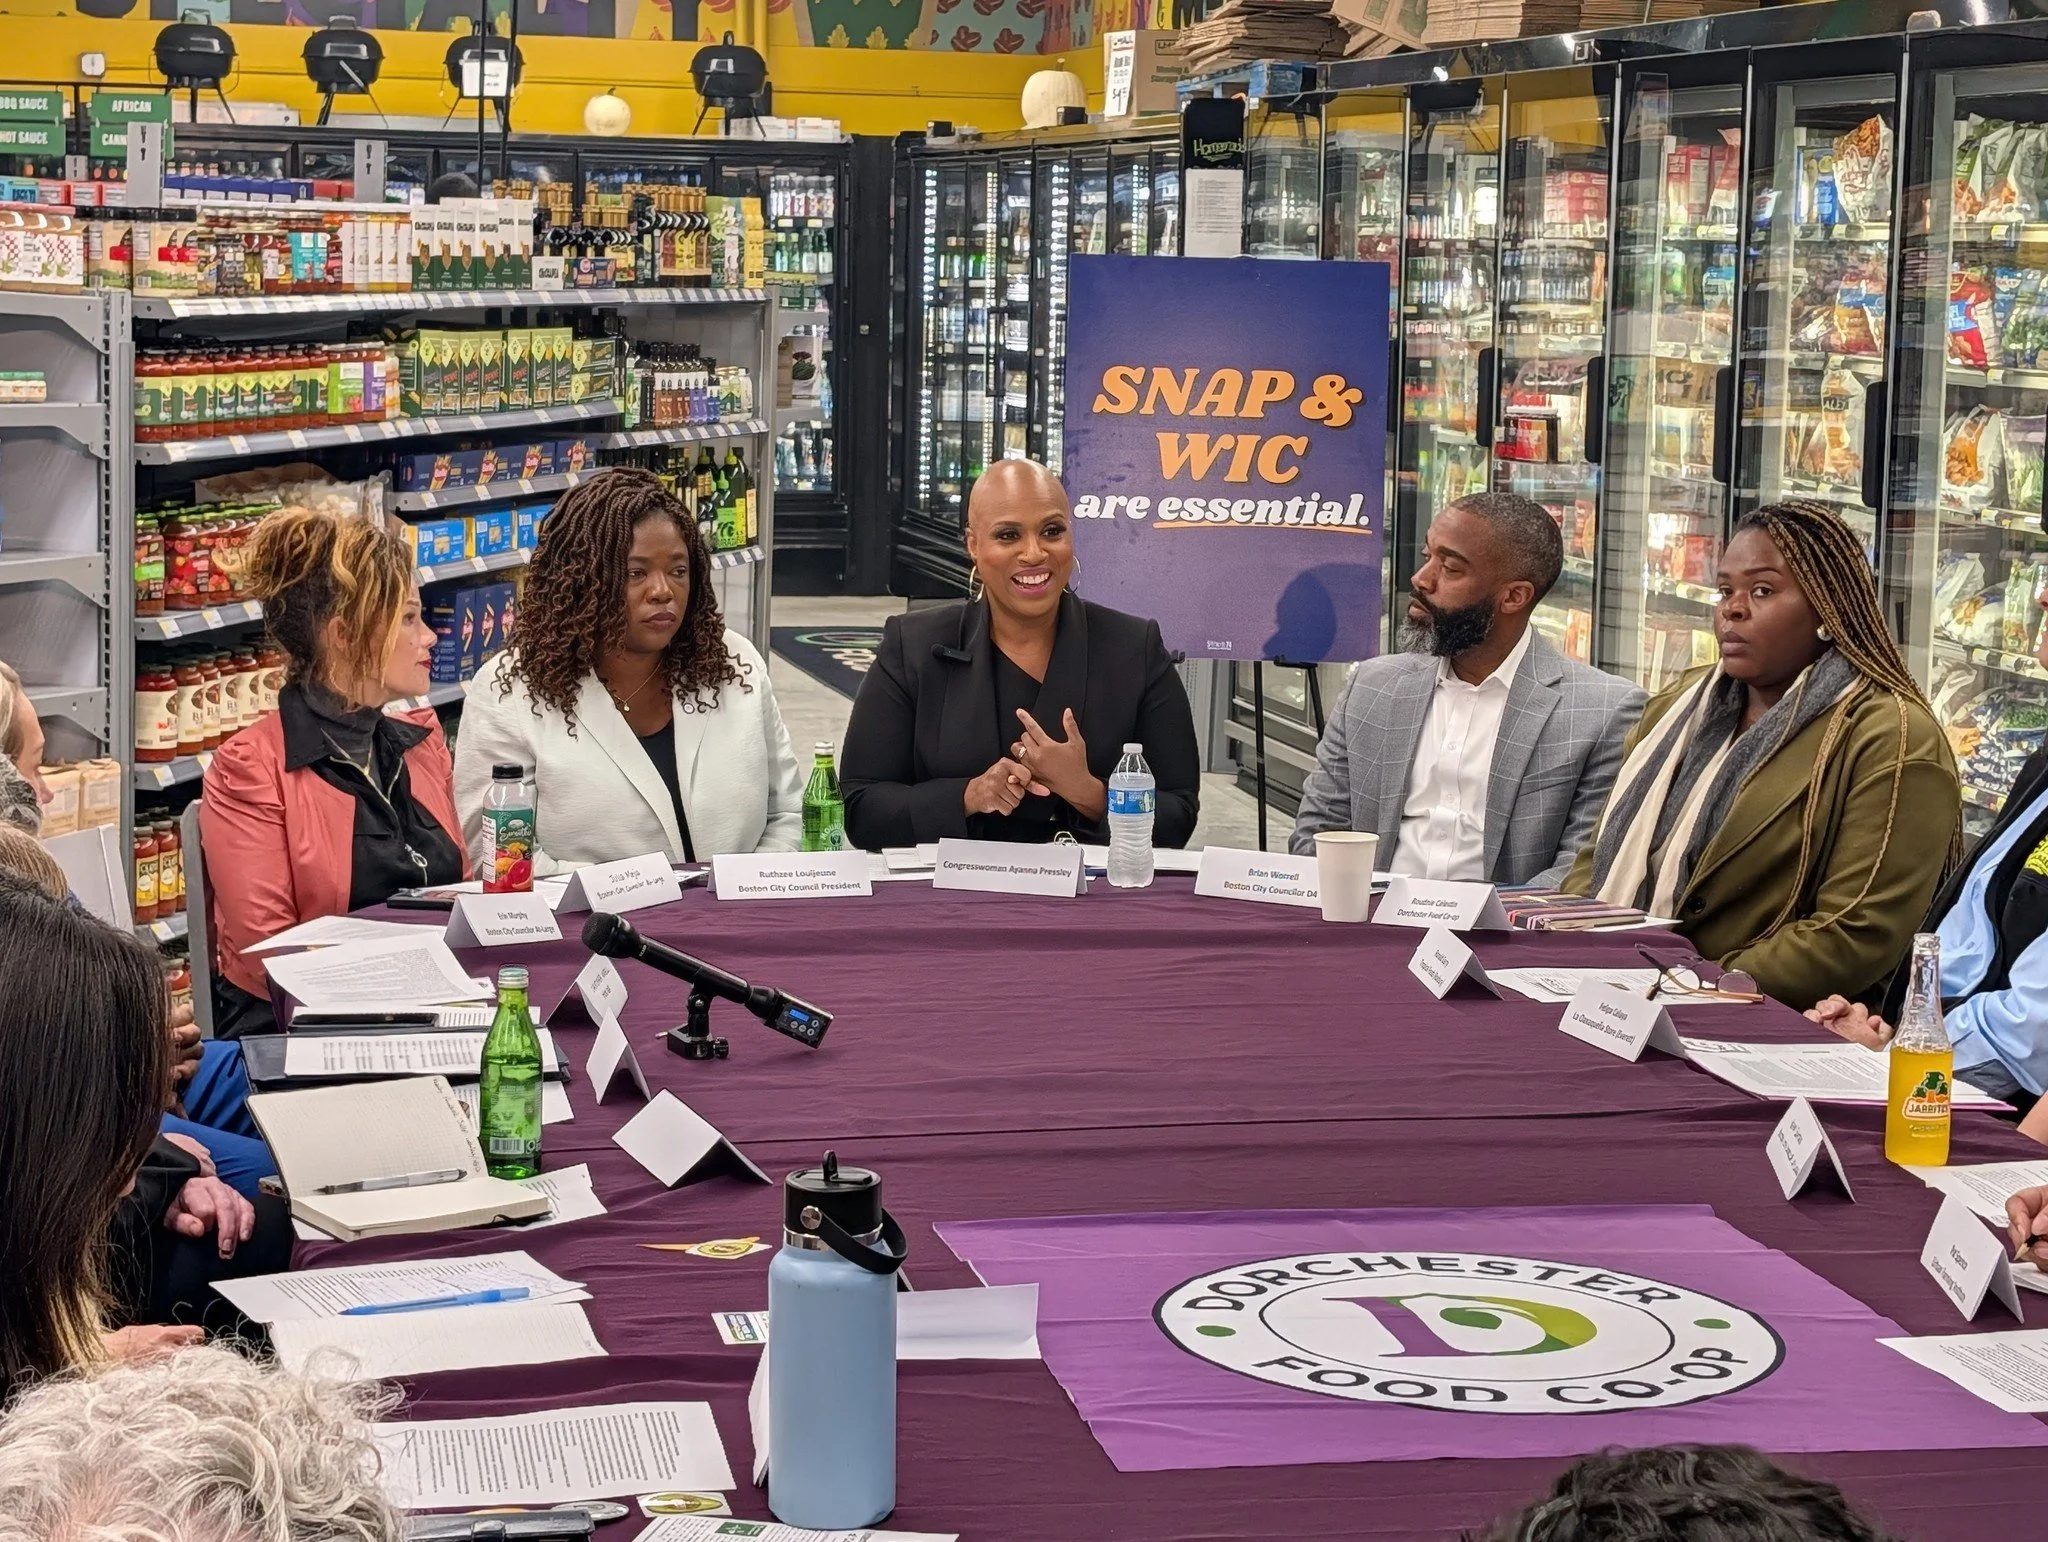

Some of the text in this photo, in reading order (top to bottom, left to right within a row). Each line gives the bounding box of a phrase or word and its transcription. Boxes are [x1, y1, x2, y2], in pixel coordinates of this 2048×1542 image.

[18, 97, 49, 110] SAUCE
[111, 100, 152, 113] AFRICAN
[18, 131, 49, 145] SAUCE
[1092, 365, 1365, 428] SNAP &
[1155, 432, 1310, 485] WIC
[1073, 491, 1371, 527] are essential.
[759, 870, 837, 879] Ruthzee Louijeune
[943, 860, 1007, 872] Congresswoman
[1039, 867, 1072, 878] Pressley
[1248, 868, 1300, 881] Brian Worrell
[738, 882, 861, 893] Boston City Council President
[1223, 881, 1318, 899] Boston City Councilor D4
[1397, 908, 1428, 918] Dorchester
[1427, 911, 1443, 920] Food
[485, 928, 503, 936] Boston
[502, 927, 514, 936] City
[1604, 1024, 1617, 1037] Store
[1182, 1254, 1682, 1314] DORCHESTER
[1251, 1346, 1753, 1406] FOOD CO-OP
